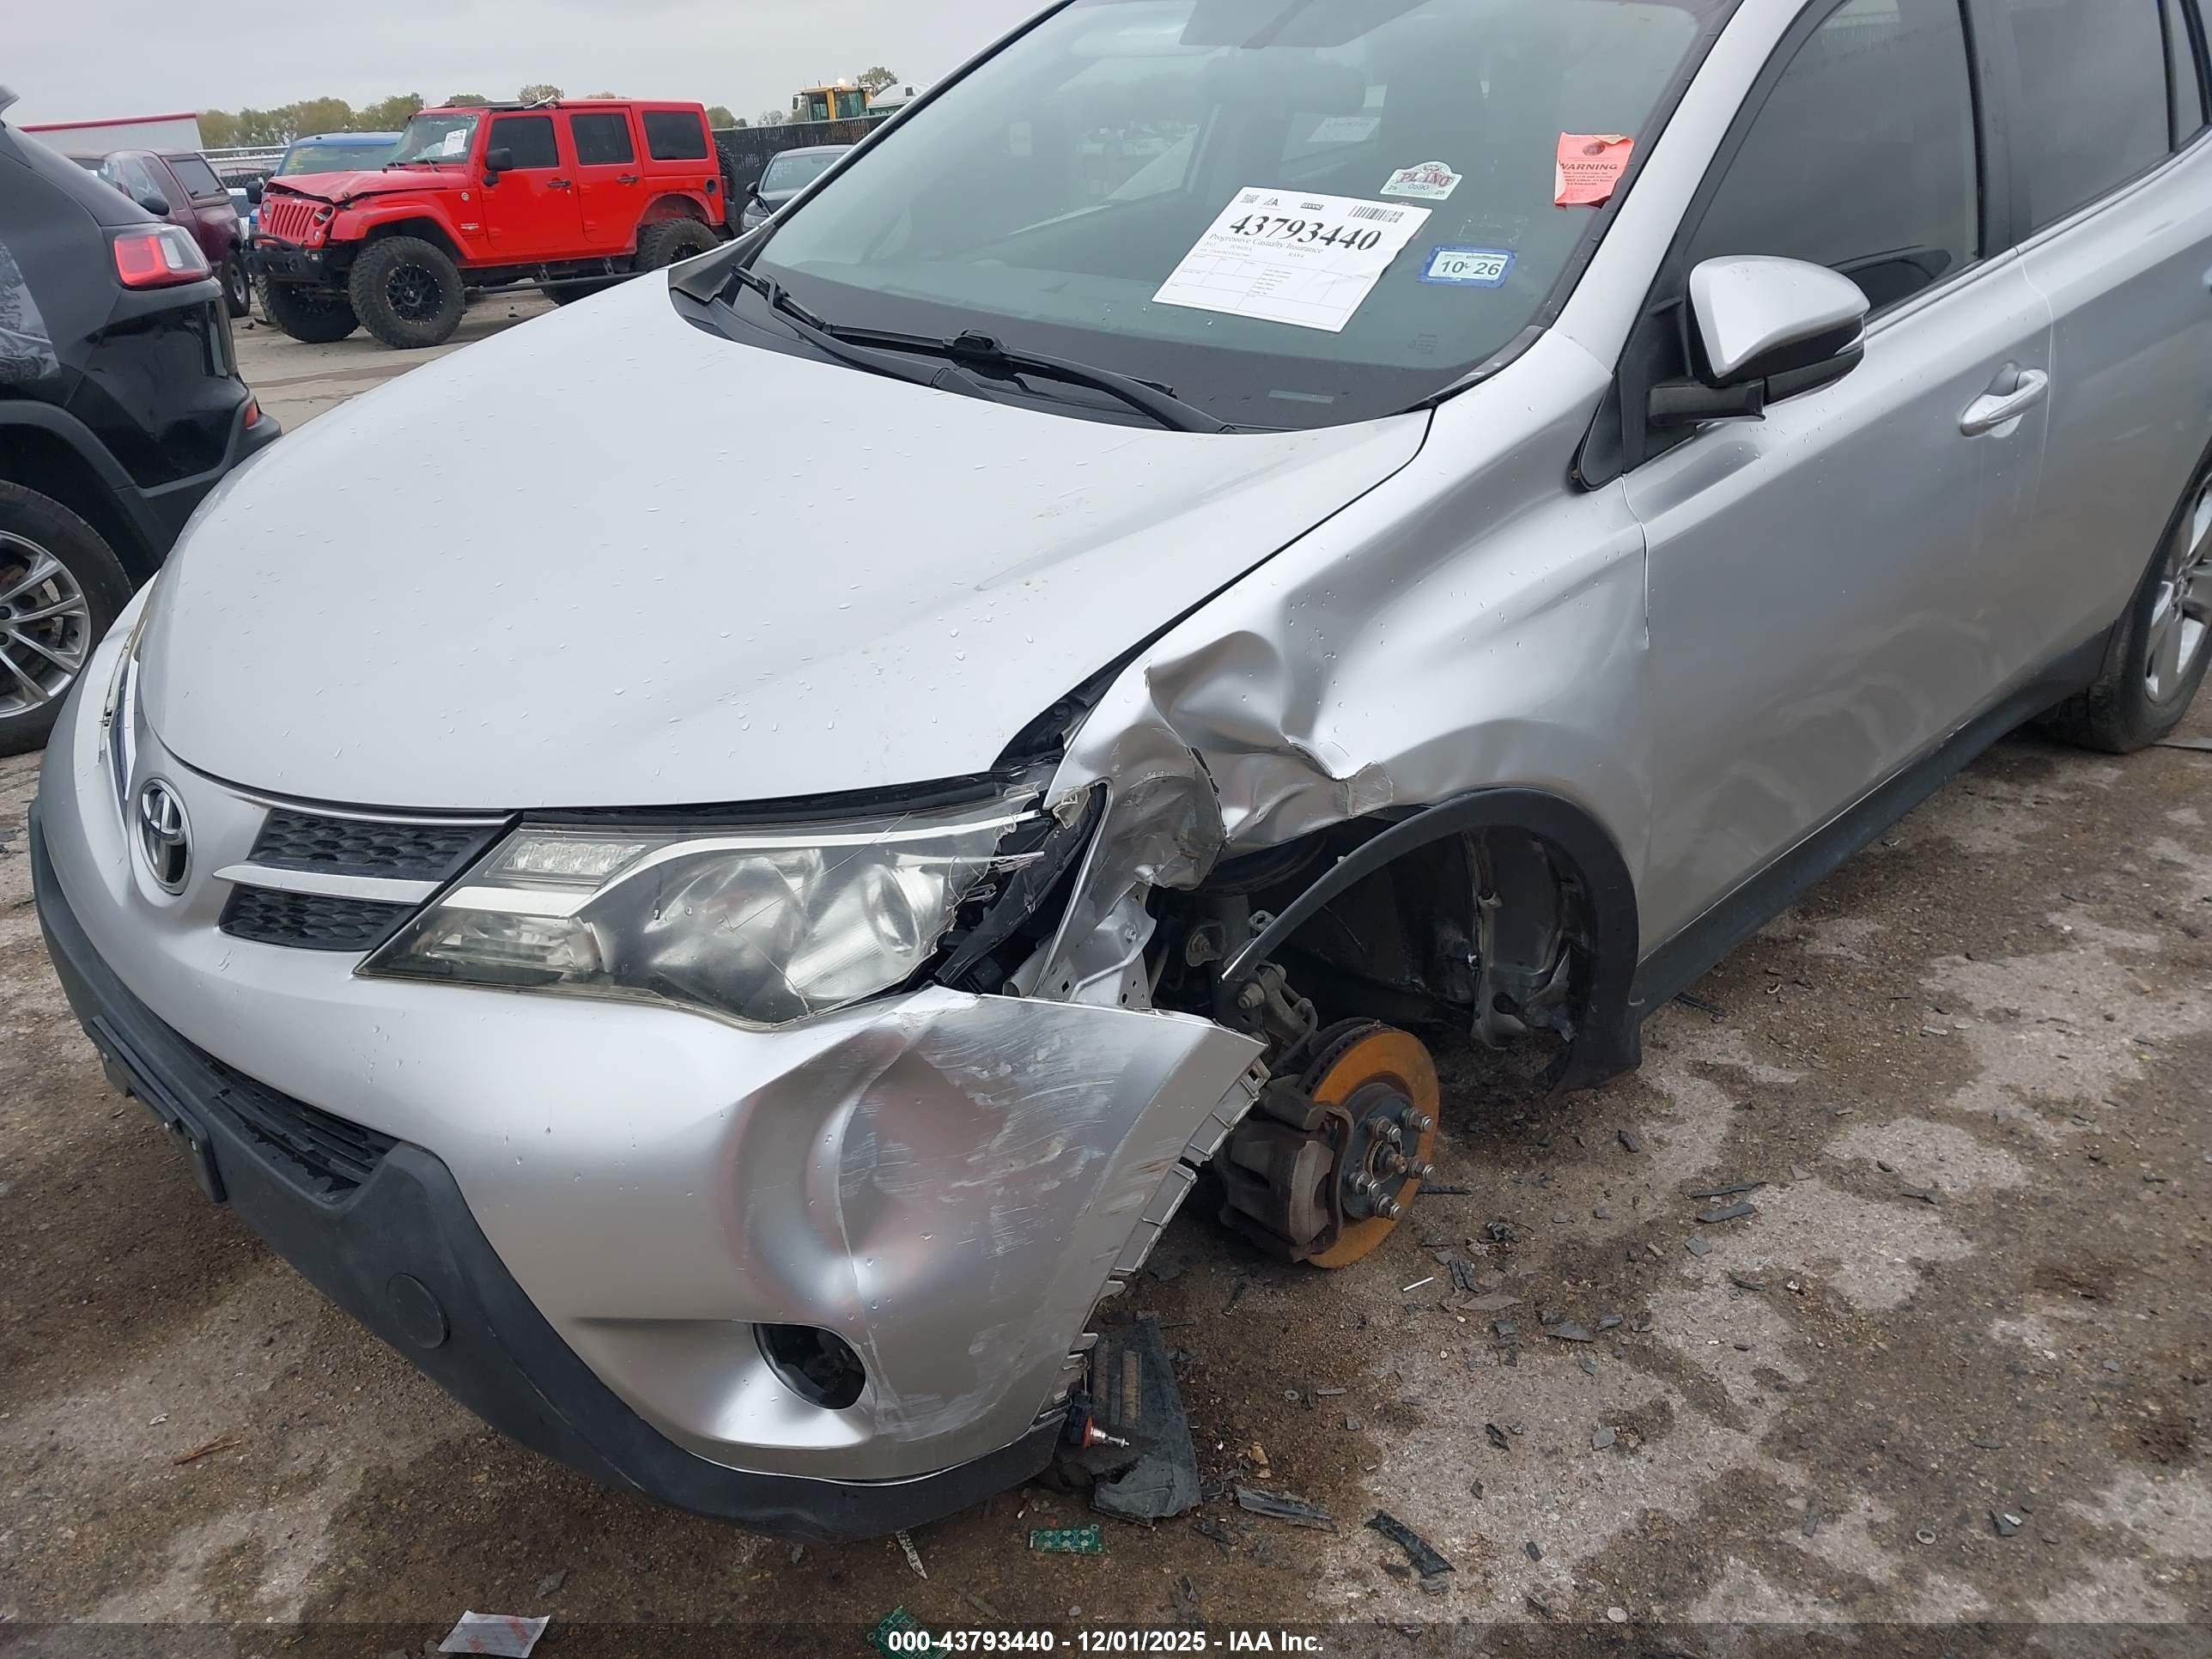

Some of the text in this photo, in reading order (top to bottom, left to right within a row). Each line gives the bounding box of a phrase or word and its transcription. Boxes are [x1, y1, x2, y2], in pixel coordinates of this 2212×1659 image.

[1559, 161, 1618, 170] WARNING
[1230, 214, 1382, 251] 43793440
[1252, 238, 1285, 249] Casualty
[1286, 242, 1324, 254] Insurance
[1442, 260, 1501, 276] 10 26
